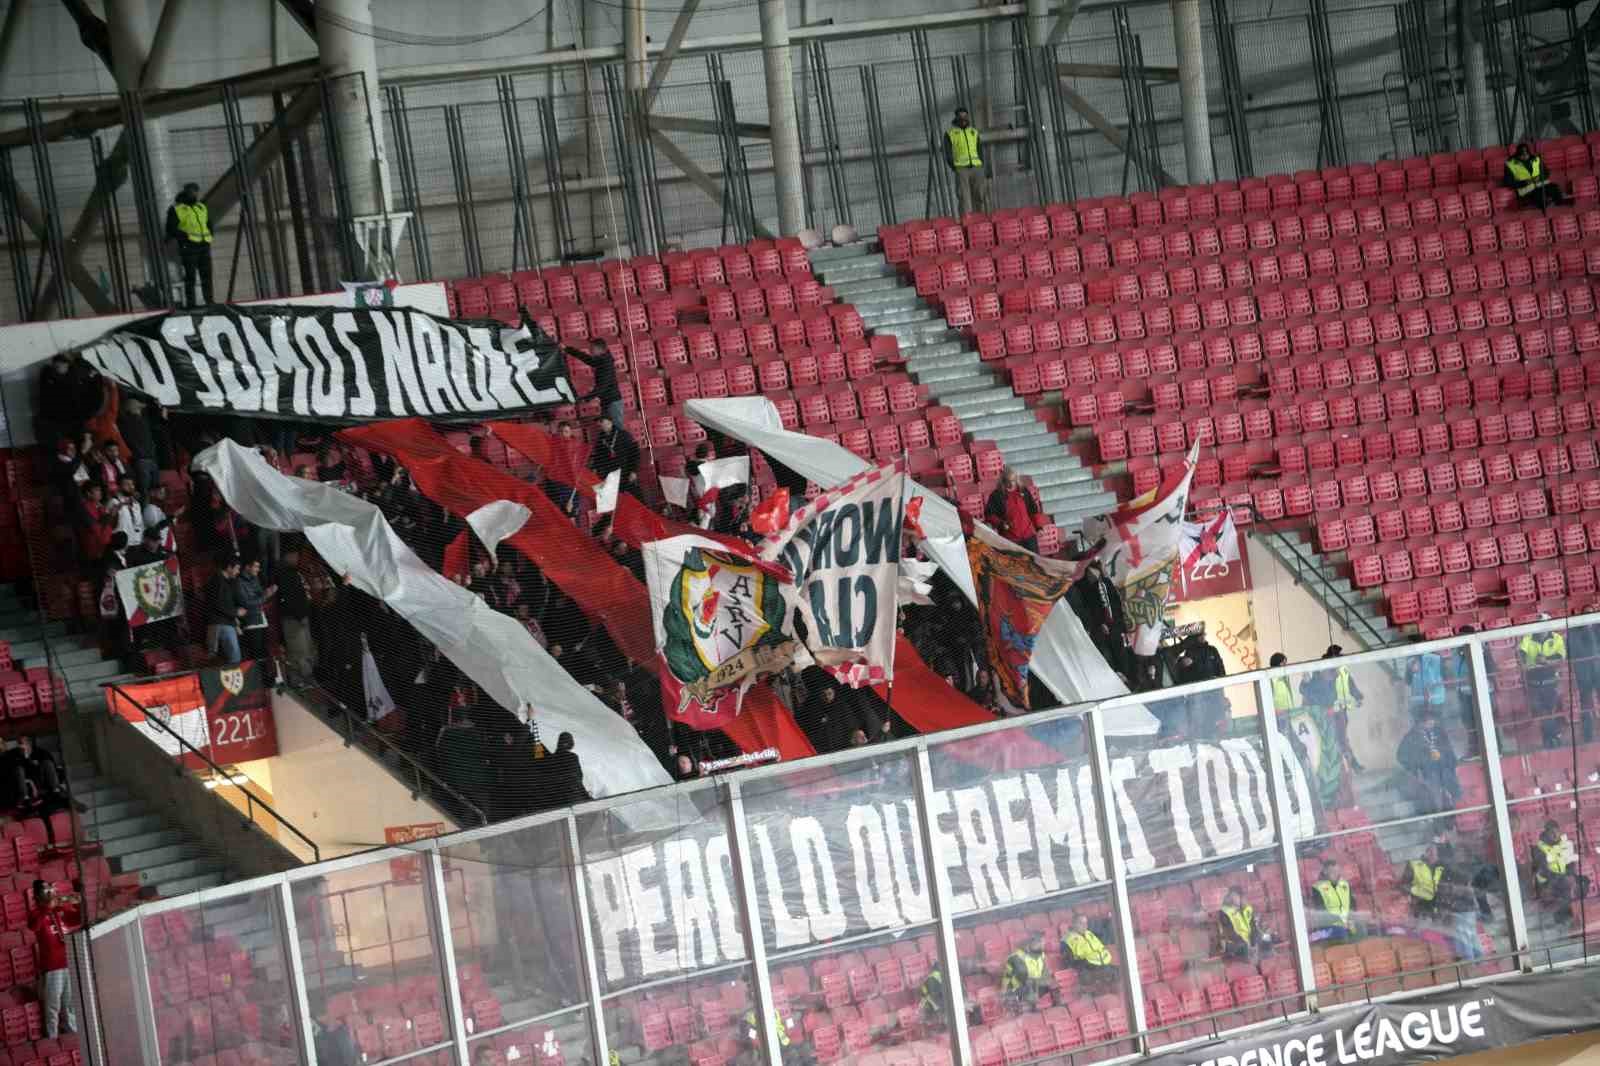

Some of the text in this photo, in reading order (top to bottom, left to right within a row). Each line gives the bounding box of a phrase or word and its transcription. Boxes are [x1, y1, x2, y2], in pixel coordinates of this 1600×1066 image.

[160, 311, 377, 417] SOMOS
[587, 833, 748, 982] PERO
[752, 816, 848, 949] LO
[1148, 732, 1315, 863] TODO
